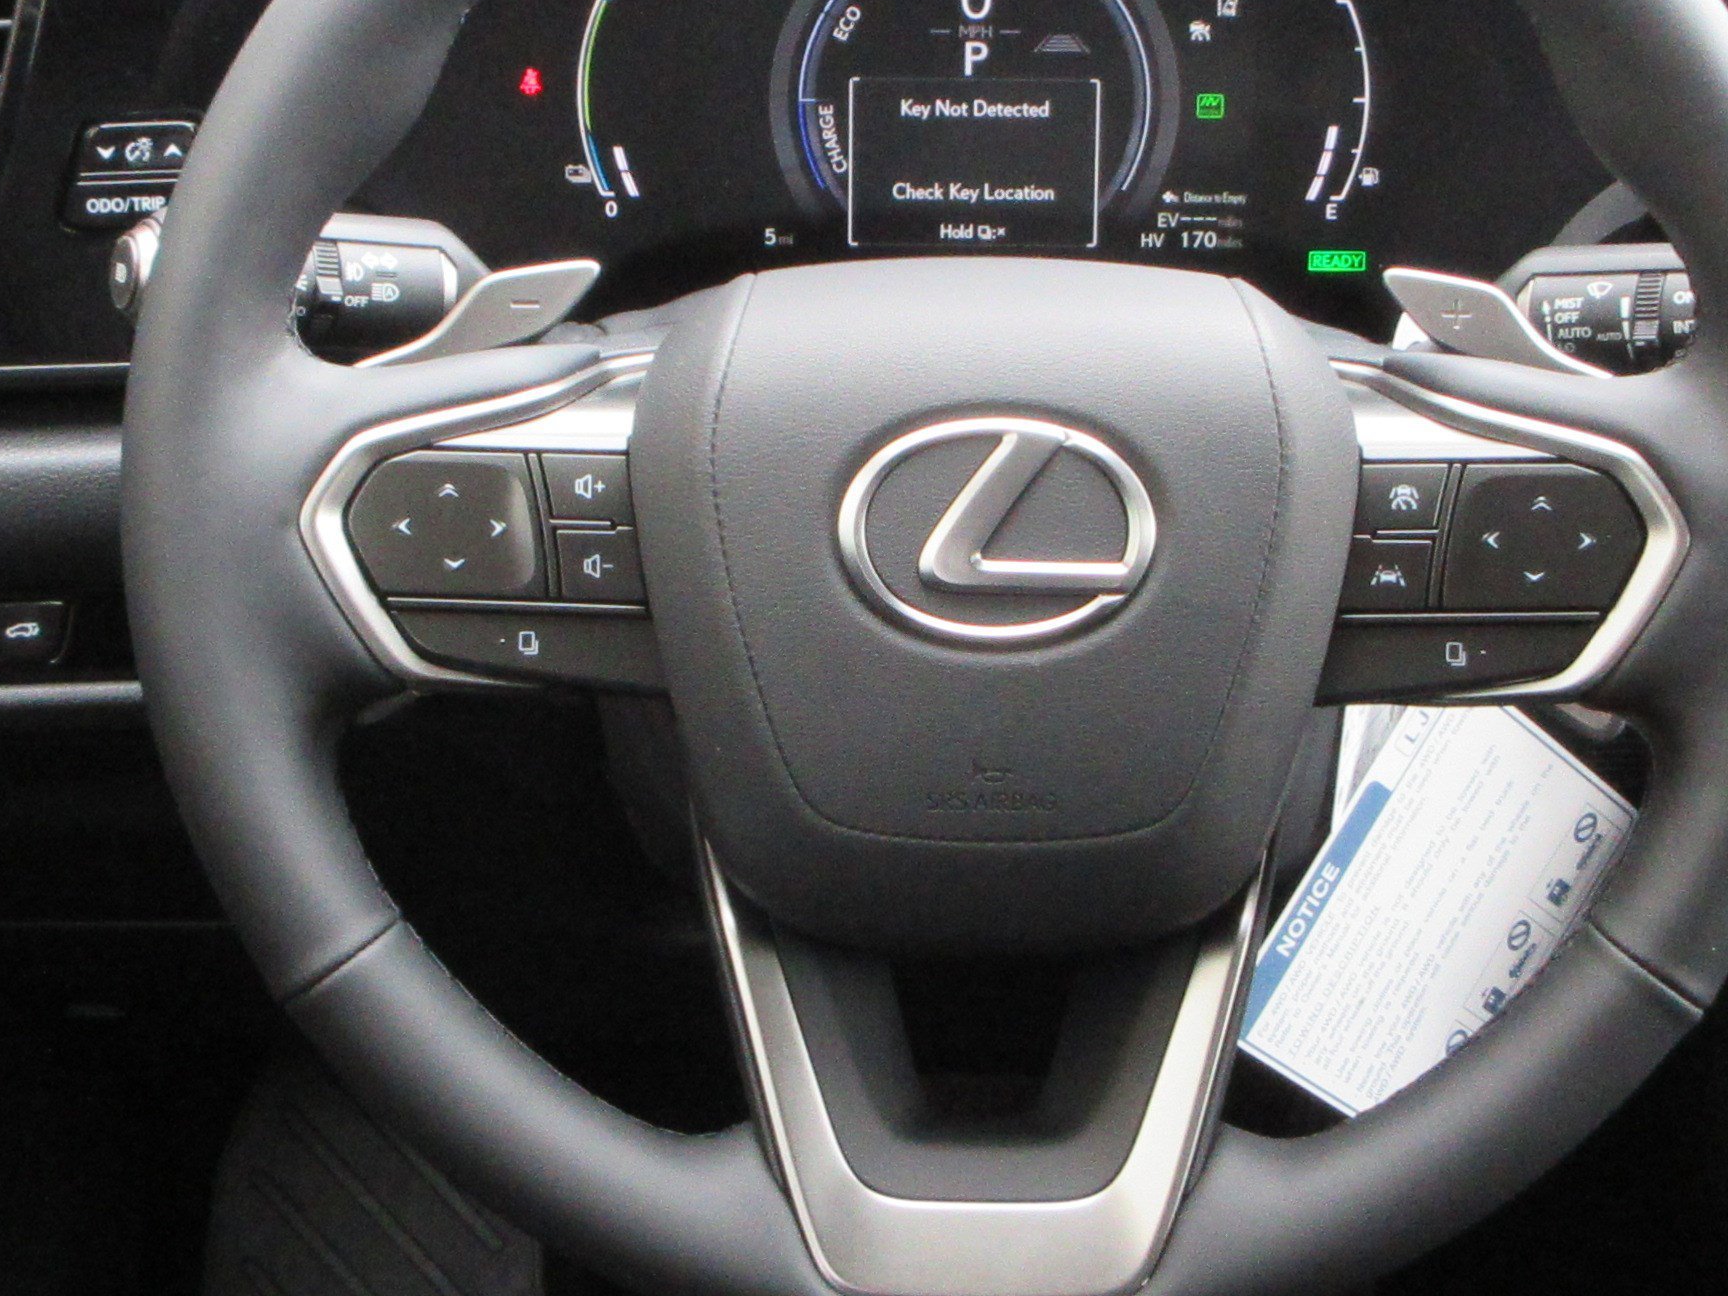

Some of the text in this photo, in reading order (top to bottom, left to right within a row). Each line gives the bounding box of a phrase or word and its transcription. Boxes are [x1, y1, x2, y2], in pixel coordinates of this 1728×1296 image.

[831, 5, 862, 43] ECO
[958, 24, 993, 39] MPH
[963, 40, 990, 77] P
[900, 98, 1051, 120] Key Not Detected
[818, 103, 849, 175] CHARGE
[891, 182, 1055, 204] Check Key Location
[85, 195, 166, 214] ODO/TRIP
[604, 200, 618, 218] 0
[1324, 203, 1339, 221] E
[1157, 212, 1180, 228] EV
[763, 227, 777, 246] 5
[939, 223, 973, 240] Hold
[1140, 232, 1166, 249] HV
[1181, 230, 1218, 249] 170
[1311, 253, 1362, 268] READY
[343, 294, 370, 307] OFF
[1553, 296, 1585, 310] MIST
[1553, 311, 1581, 324] OFF
[1558, 326, 1592, 339] AUTO
[1273, 859, 1342, 959] NOTICE
